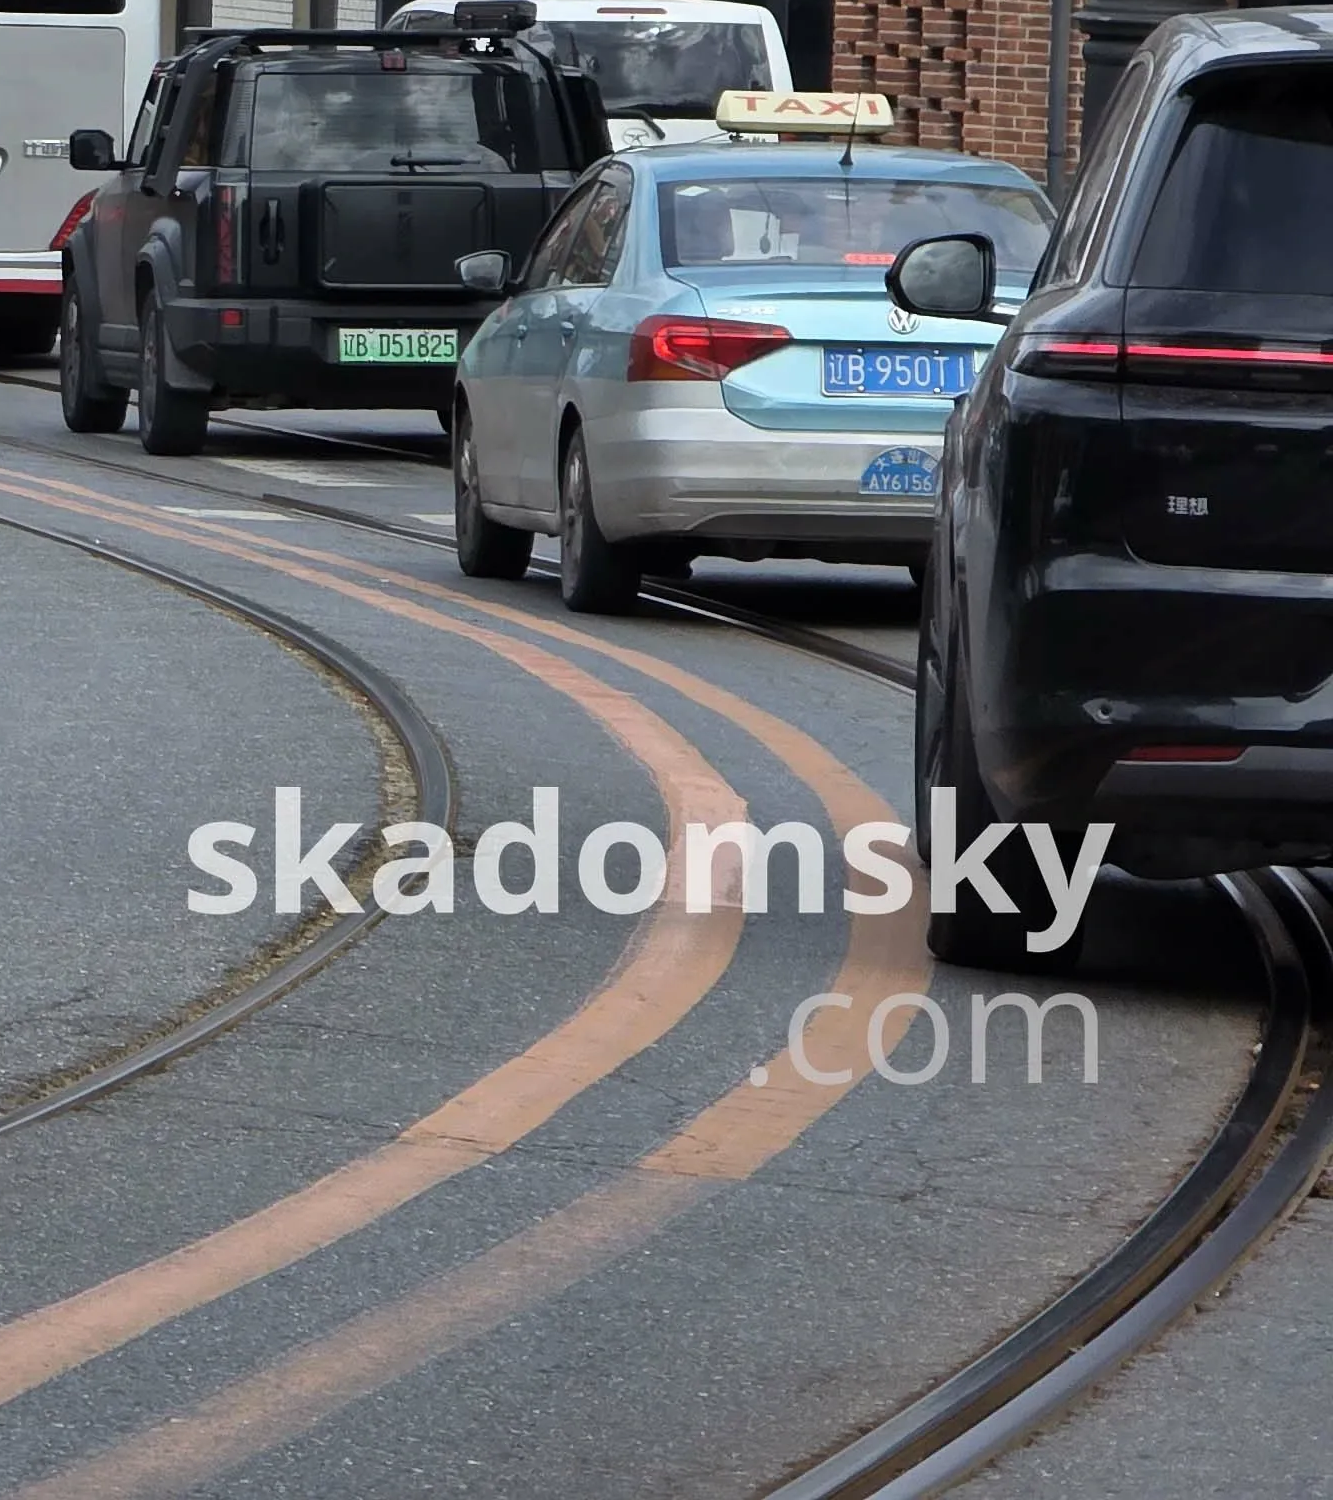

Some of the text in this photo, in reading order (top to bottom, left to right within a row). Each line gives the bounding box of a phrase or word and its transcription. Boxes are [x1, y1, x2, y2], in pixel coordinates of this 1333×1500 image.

[734, 95, 880, 117] TAXI
[378, 333, 455, 358] D51825
[868, 473, 933, 492] AY6156
[1166, 495, 1208, 516] 理想
